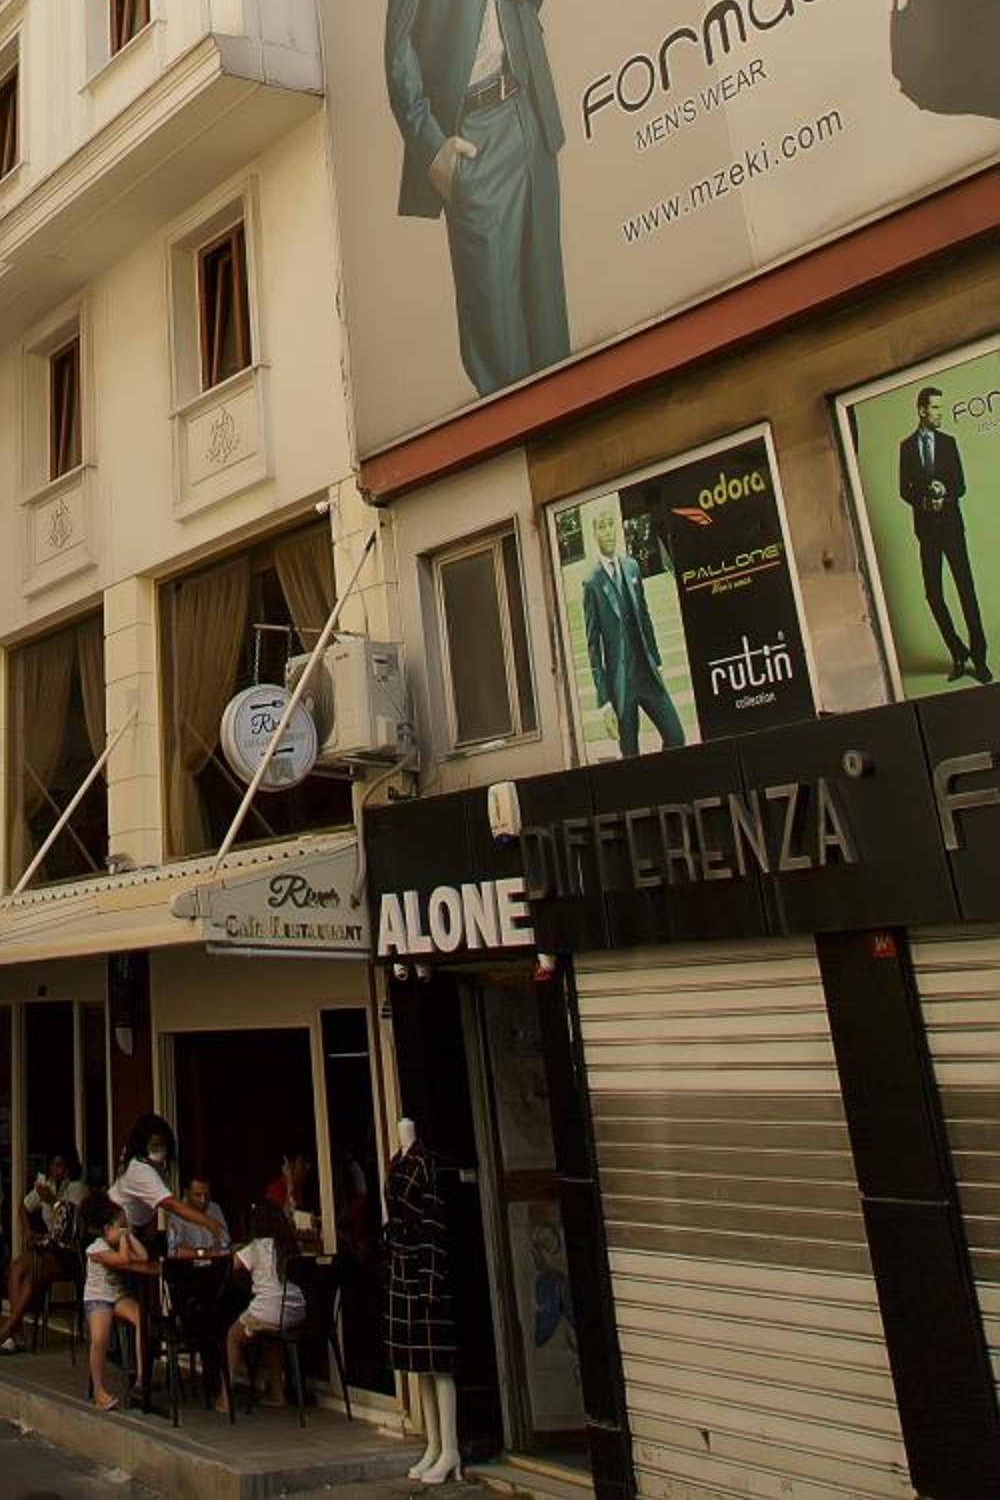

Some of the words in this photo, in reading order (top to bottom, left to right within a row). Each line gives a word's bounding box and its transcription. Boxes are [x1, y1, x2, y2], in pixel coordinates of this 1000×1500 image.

[634, 100, 698, 150] MEN'S
[700, 58, 767, 112] WEAR
[622, 109, 844, 244] www.mzeki.com
[699, 469, 765, 510] adora
[520, 777, 858, 900] DIFFERENZA
[377, 878, 535, 958] ALONE
